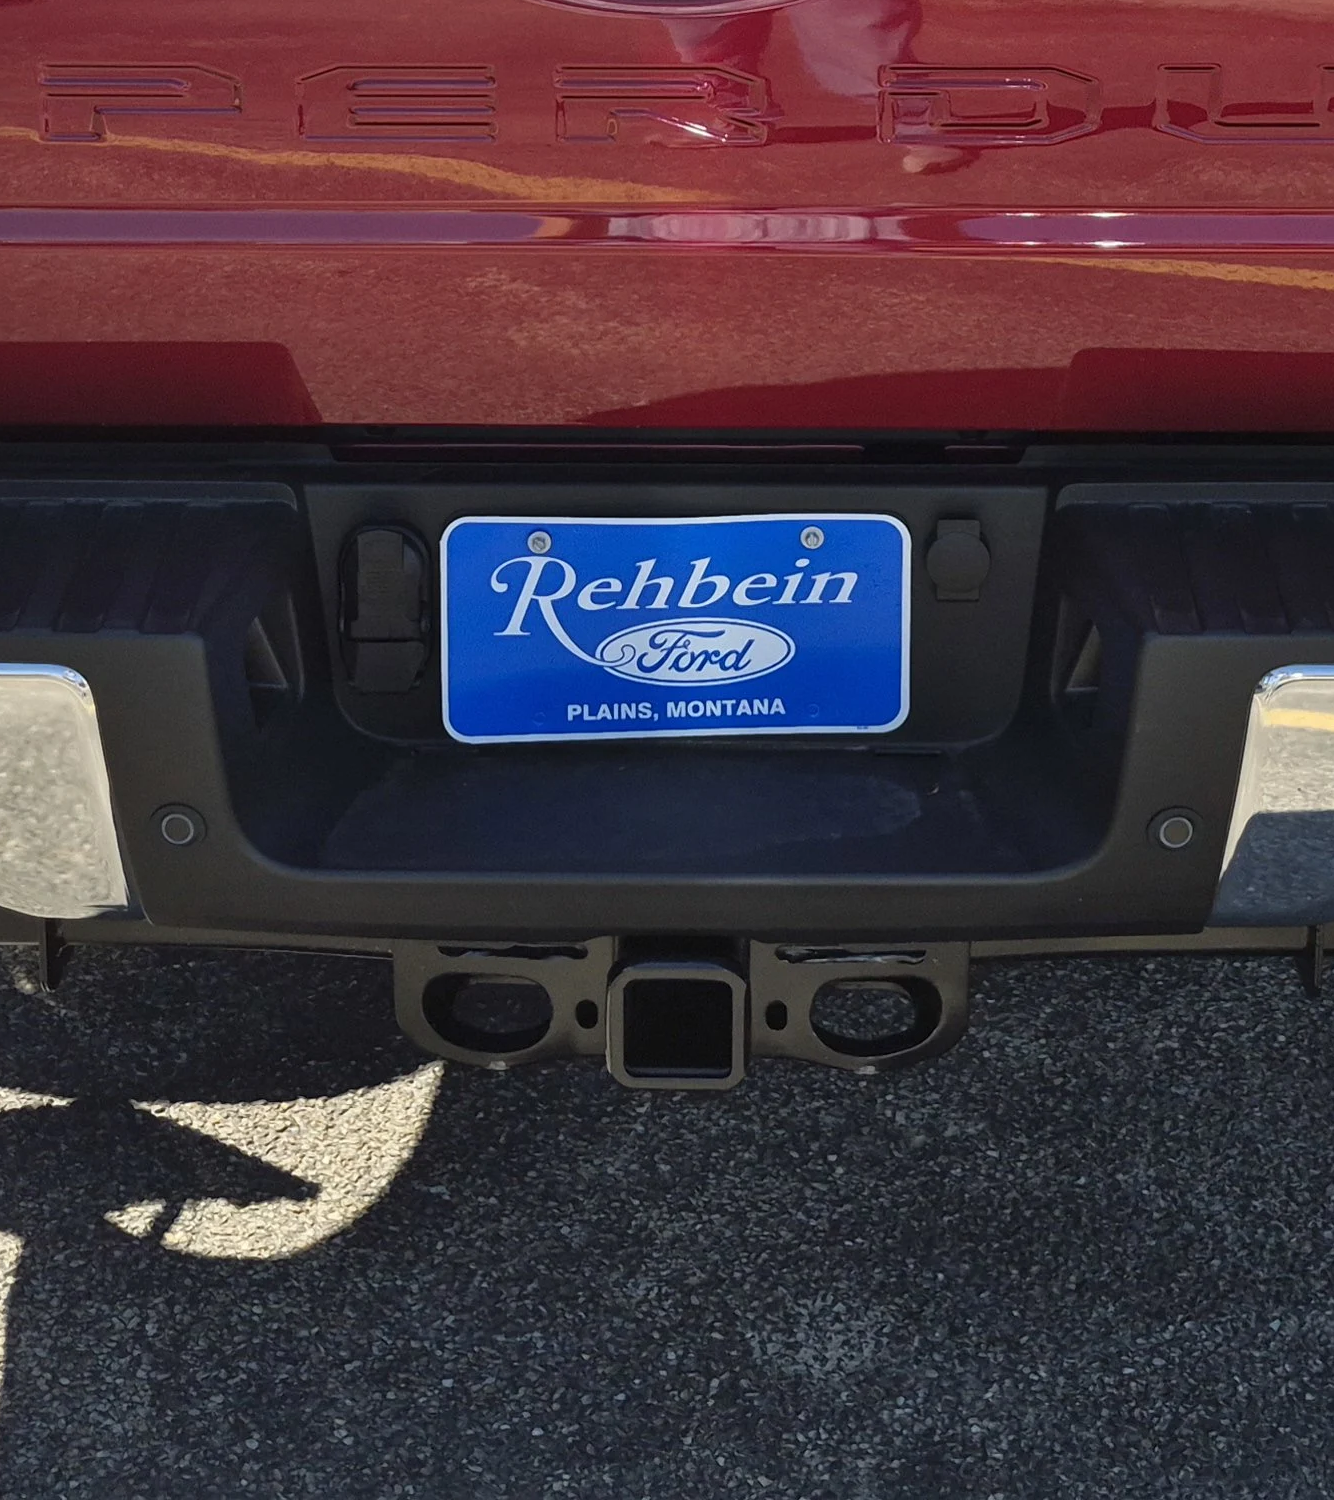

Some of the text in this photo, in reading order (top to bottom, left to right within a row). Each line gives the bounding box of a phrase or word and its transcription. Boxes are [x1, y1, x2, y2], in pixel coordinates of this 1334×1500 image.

[490, 555, 859, 667] Rehbein
[636, 629, 753, 673] Ford
[566, 697, 787, 722] PLAINS, MONTANA
